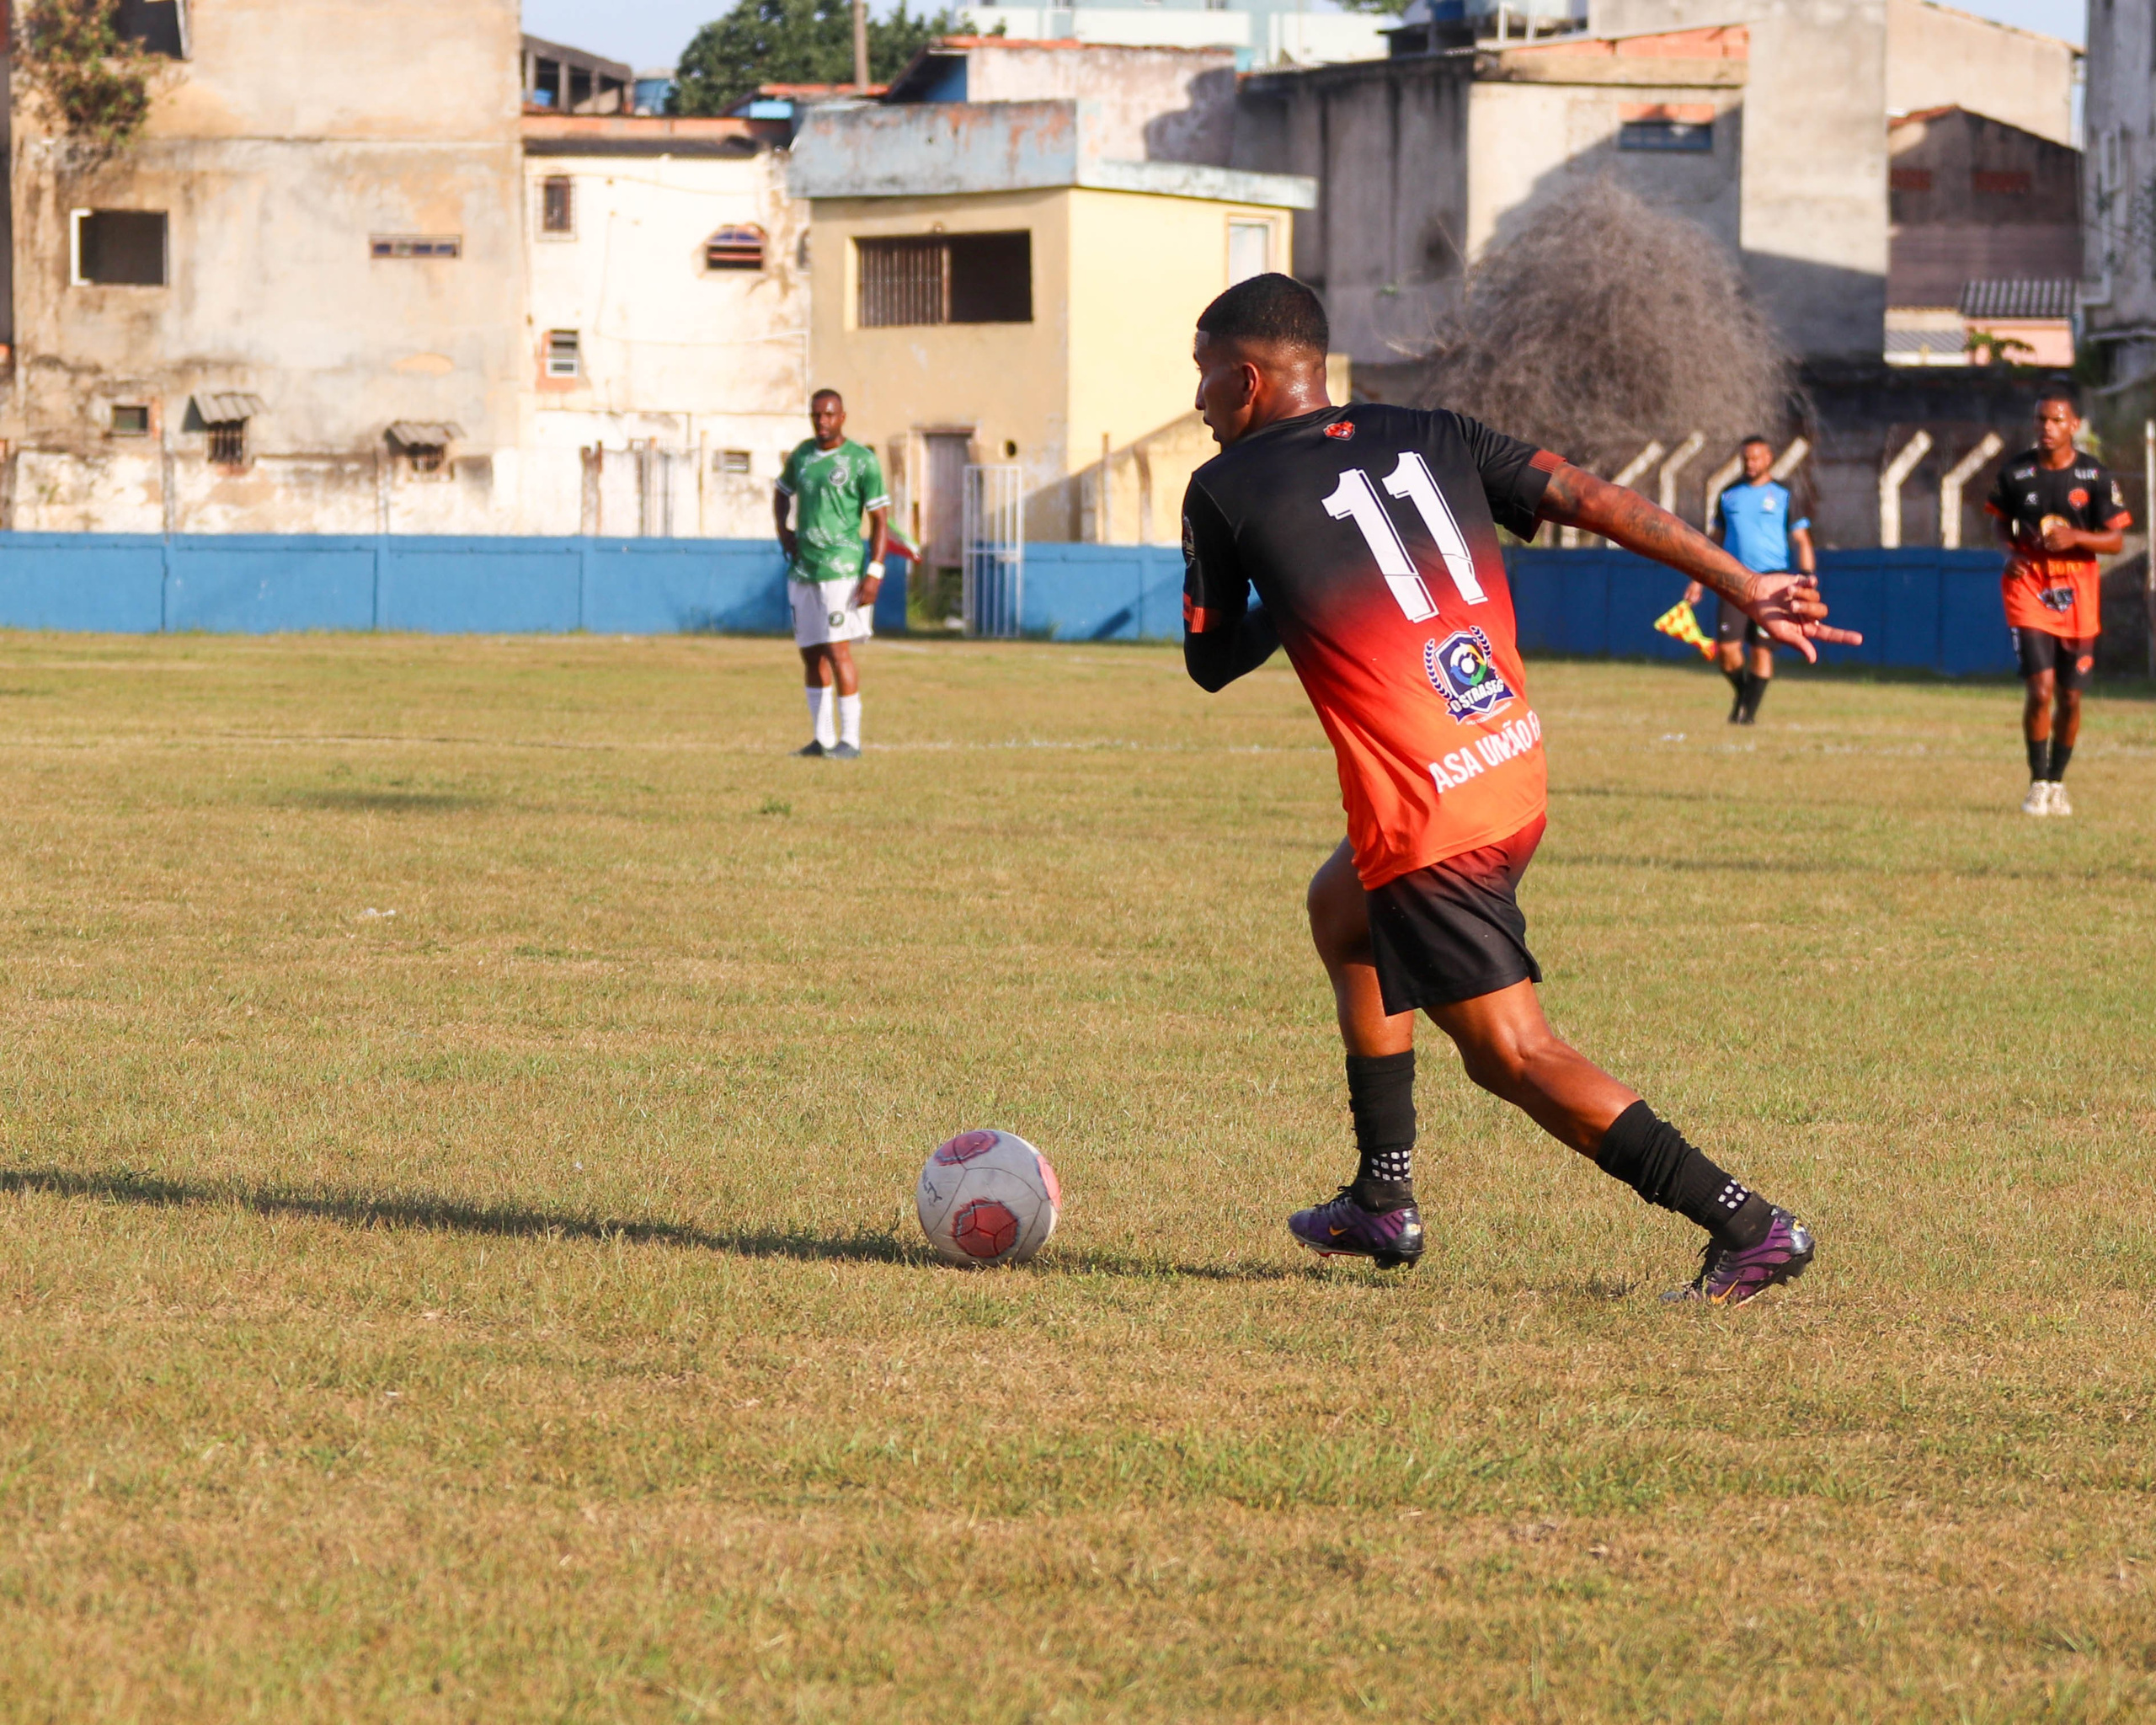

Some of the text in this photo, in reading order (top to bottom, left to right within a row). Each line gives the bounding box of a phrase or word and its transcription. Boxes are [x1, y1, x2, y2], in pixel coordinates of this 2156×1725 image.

[1321, 451, 1488, 623] 11
[1449, 678, 1505, 713] OSTRASEG
[1428, 747, 1484, 793] ASA
